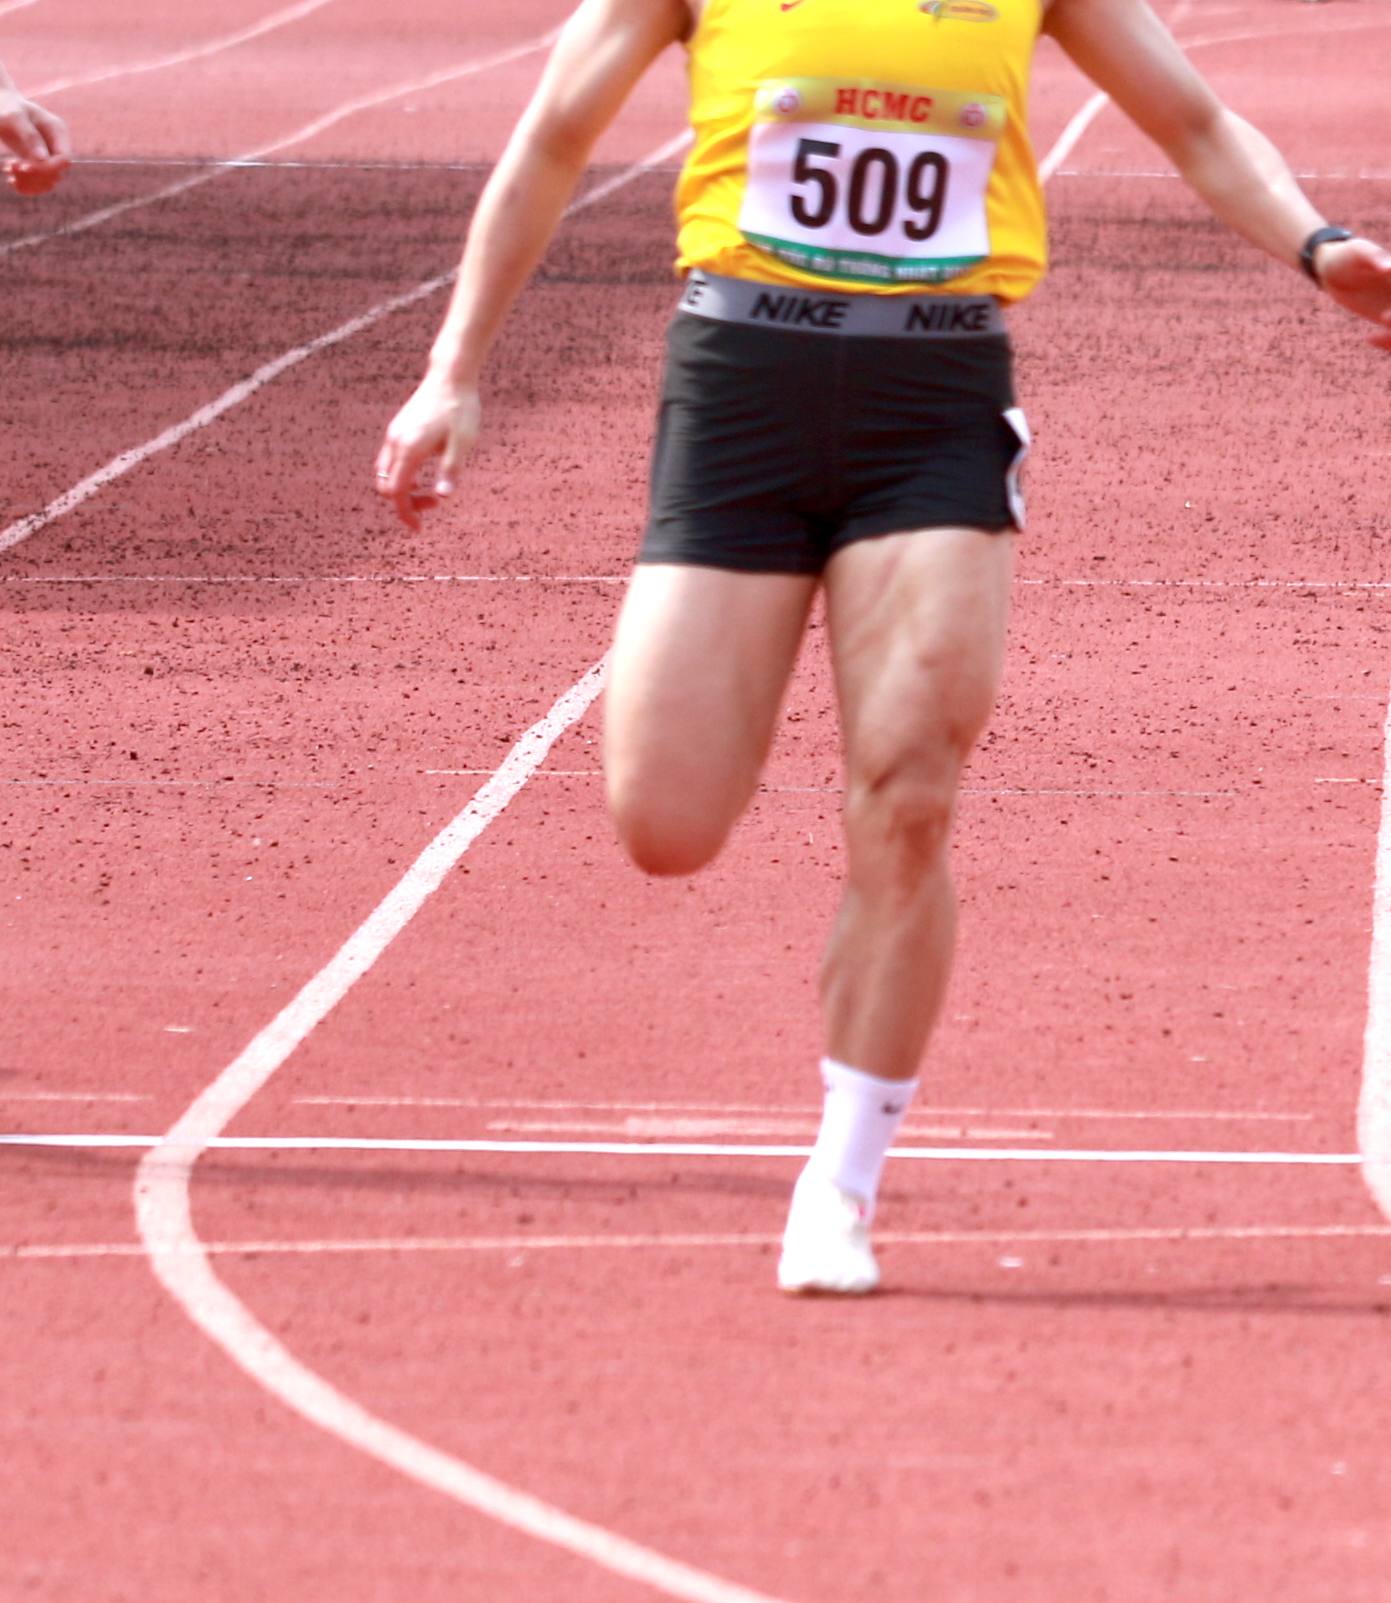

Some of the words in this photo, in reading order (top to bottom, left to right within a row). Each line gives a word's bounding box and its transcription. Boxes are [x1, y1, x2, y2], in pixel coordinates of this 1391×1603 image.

[834, 87, 934, 124] HCMC
[789, 138, 949, 242] 509
[749, 292, 850, 329] NIKE
[904, 303, 991, 332] NIKE
